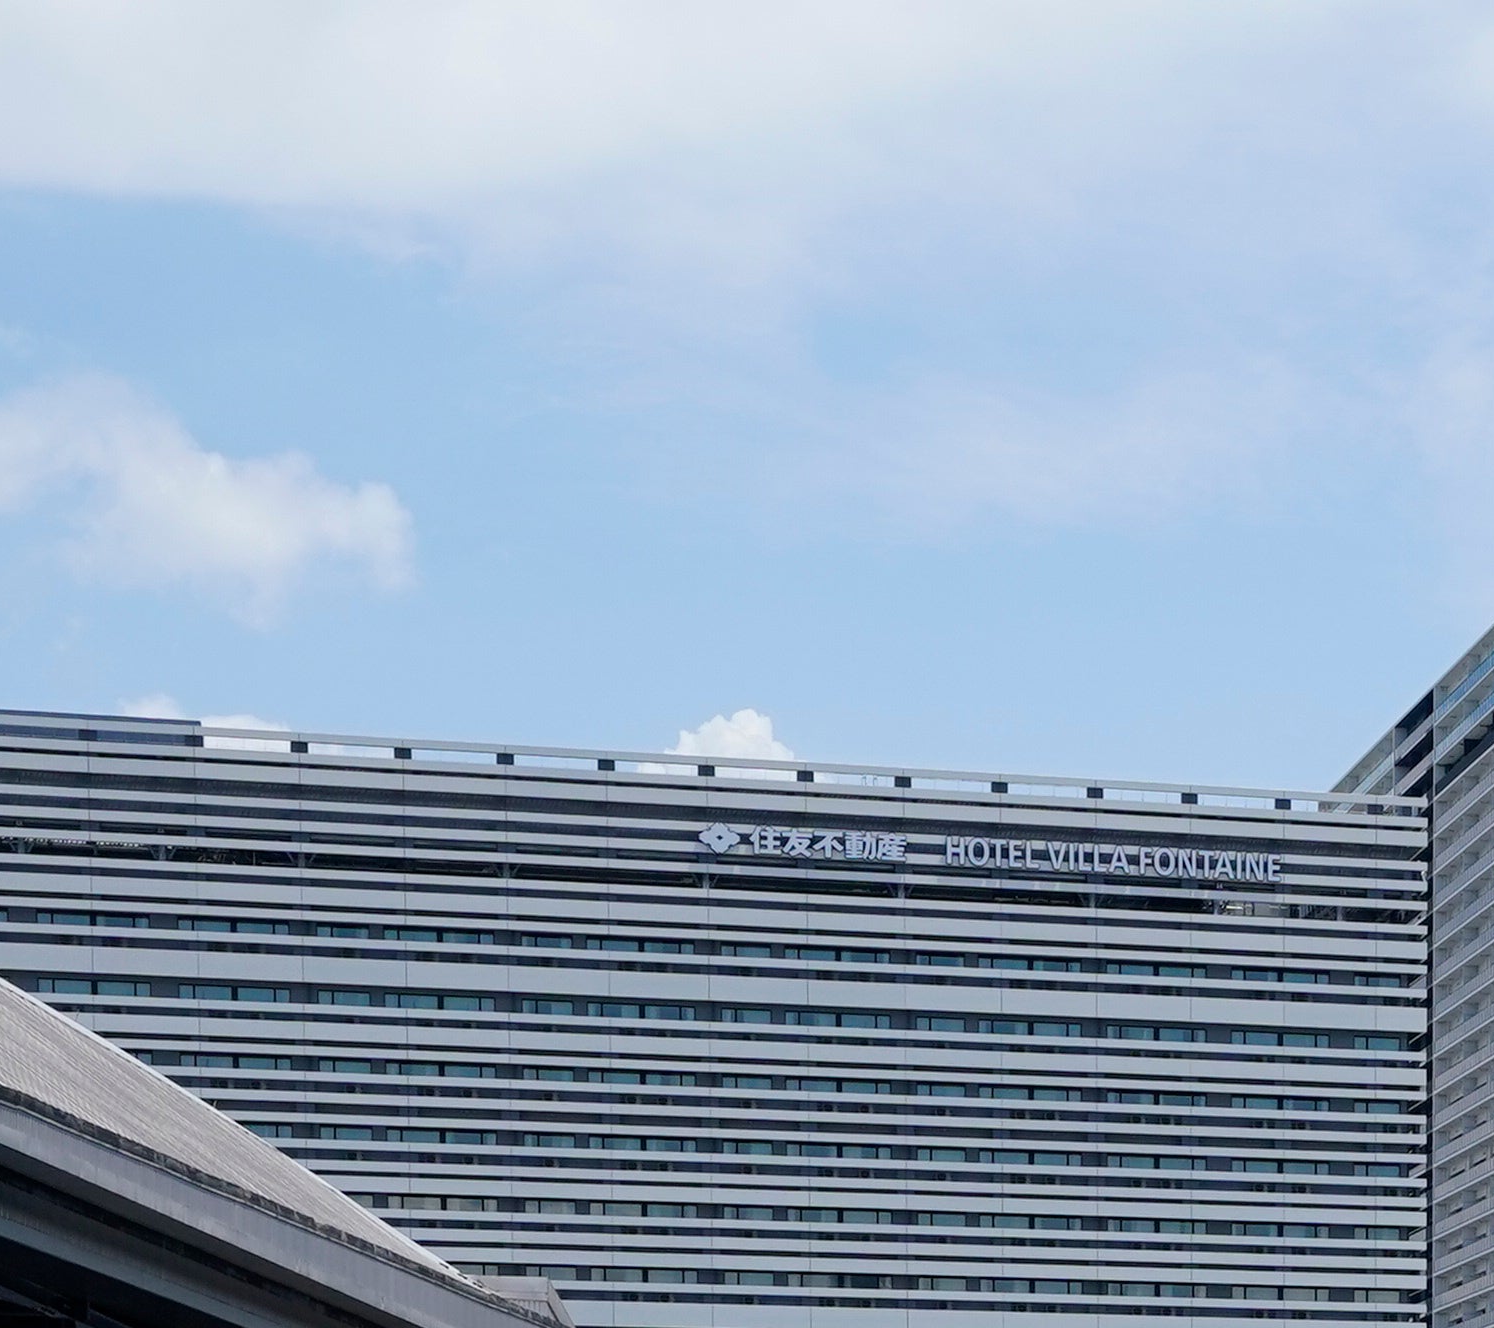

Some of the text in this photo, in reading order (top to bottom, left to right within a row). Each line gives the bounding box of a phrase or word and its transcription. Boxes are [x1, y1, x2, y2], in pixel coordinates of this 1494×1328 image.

[749, 826, 907, 864] 住友不動産
[945, 836, 1283, 884] HOTEL VILLA FONTAINE
